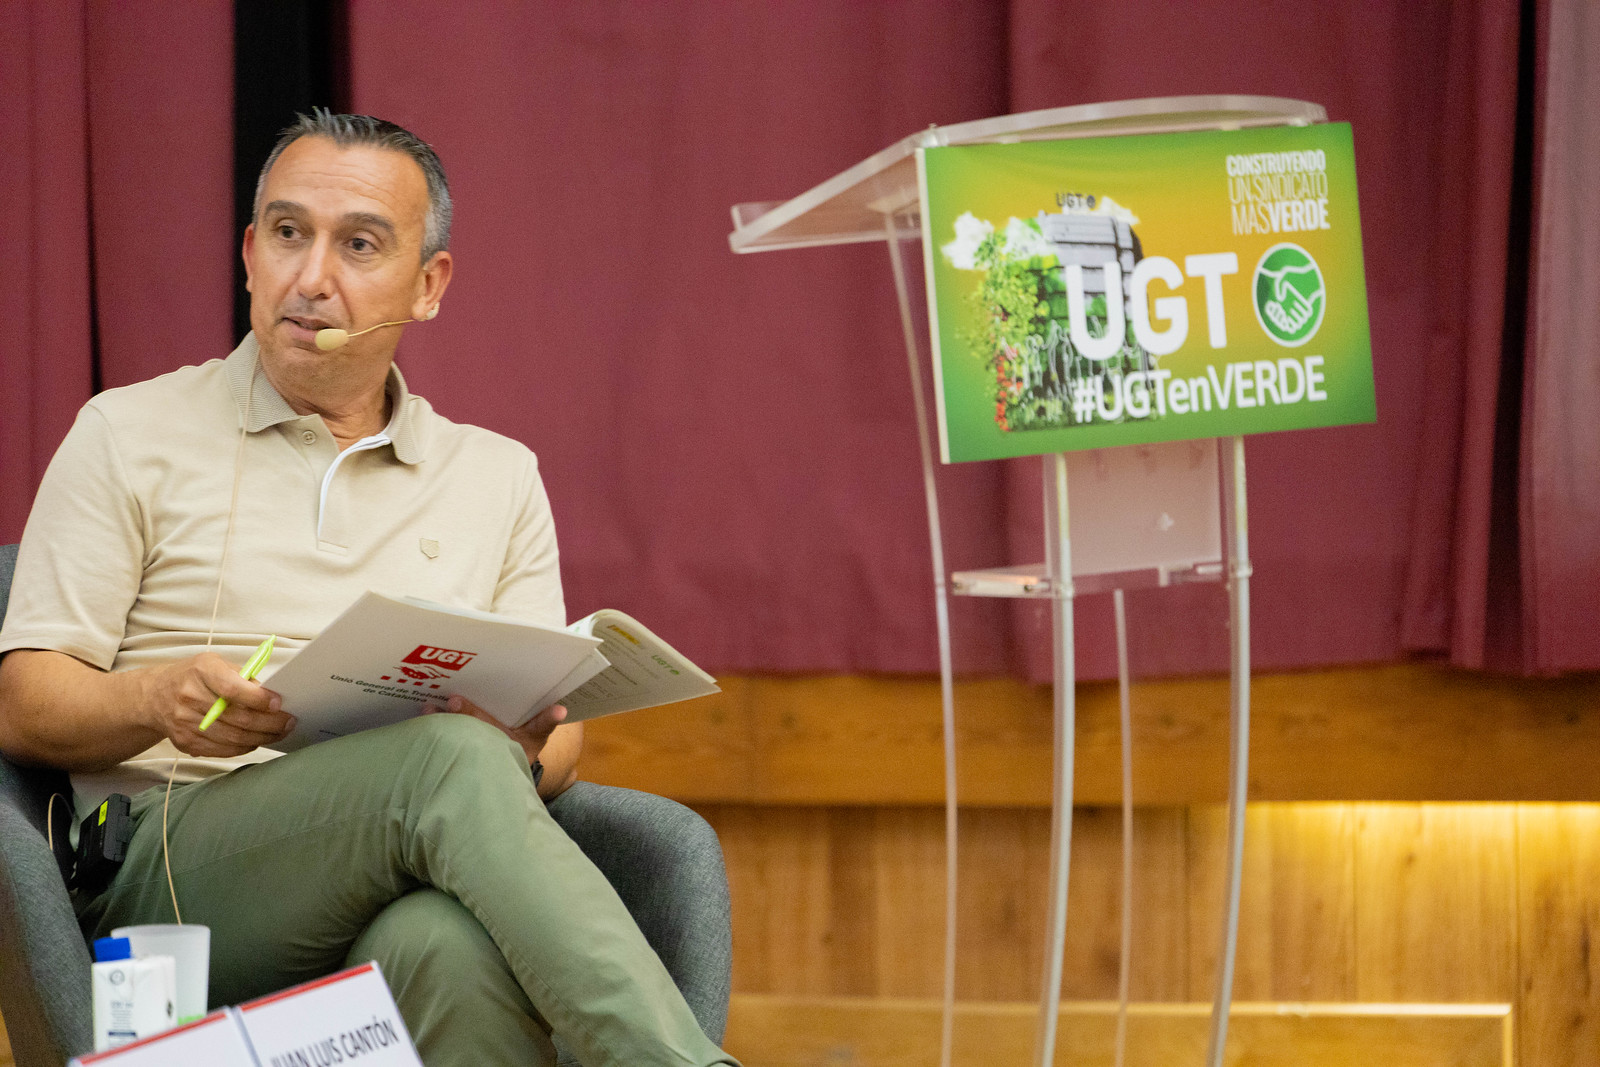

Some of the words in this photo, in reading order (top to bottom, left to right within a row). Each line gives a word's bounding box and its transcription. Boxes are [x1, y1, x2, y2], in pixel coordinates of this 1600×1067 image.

[1226, 149, 1326, 176] CONSTRUYENDO
[1055, 192, 1083, 208] UGT
[1065, 252, 1239, 361] UGT
[1073, 355, 1328, 424] #UGTenVERDE
[420, 647, 477, 665] UGT
[355, 680, 396, 691] General
[396, 685, 409, 693] de
[411, 689, 451, 702] Treballa
[378, 690, 428, 702] Catalunya
[307, 1036, 344, 1067] LUIS
[339, 1014, 400, 1059] CANTÓN
